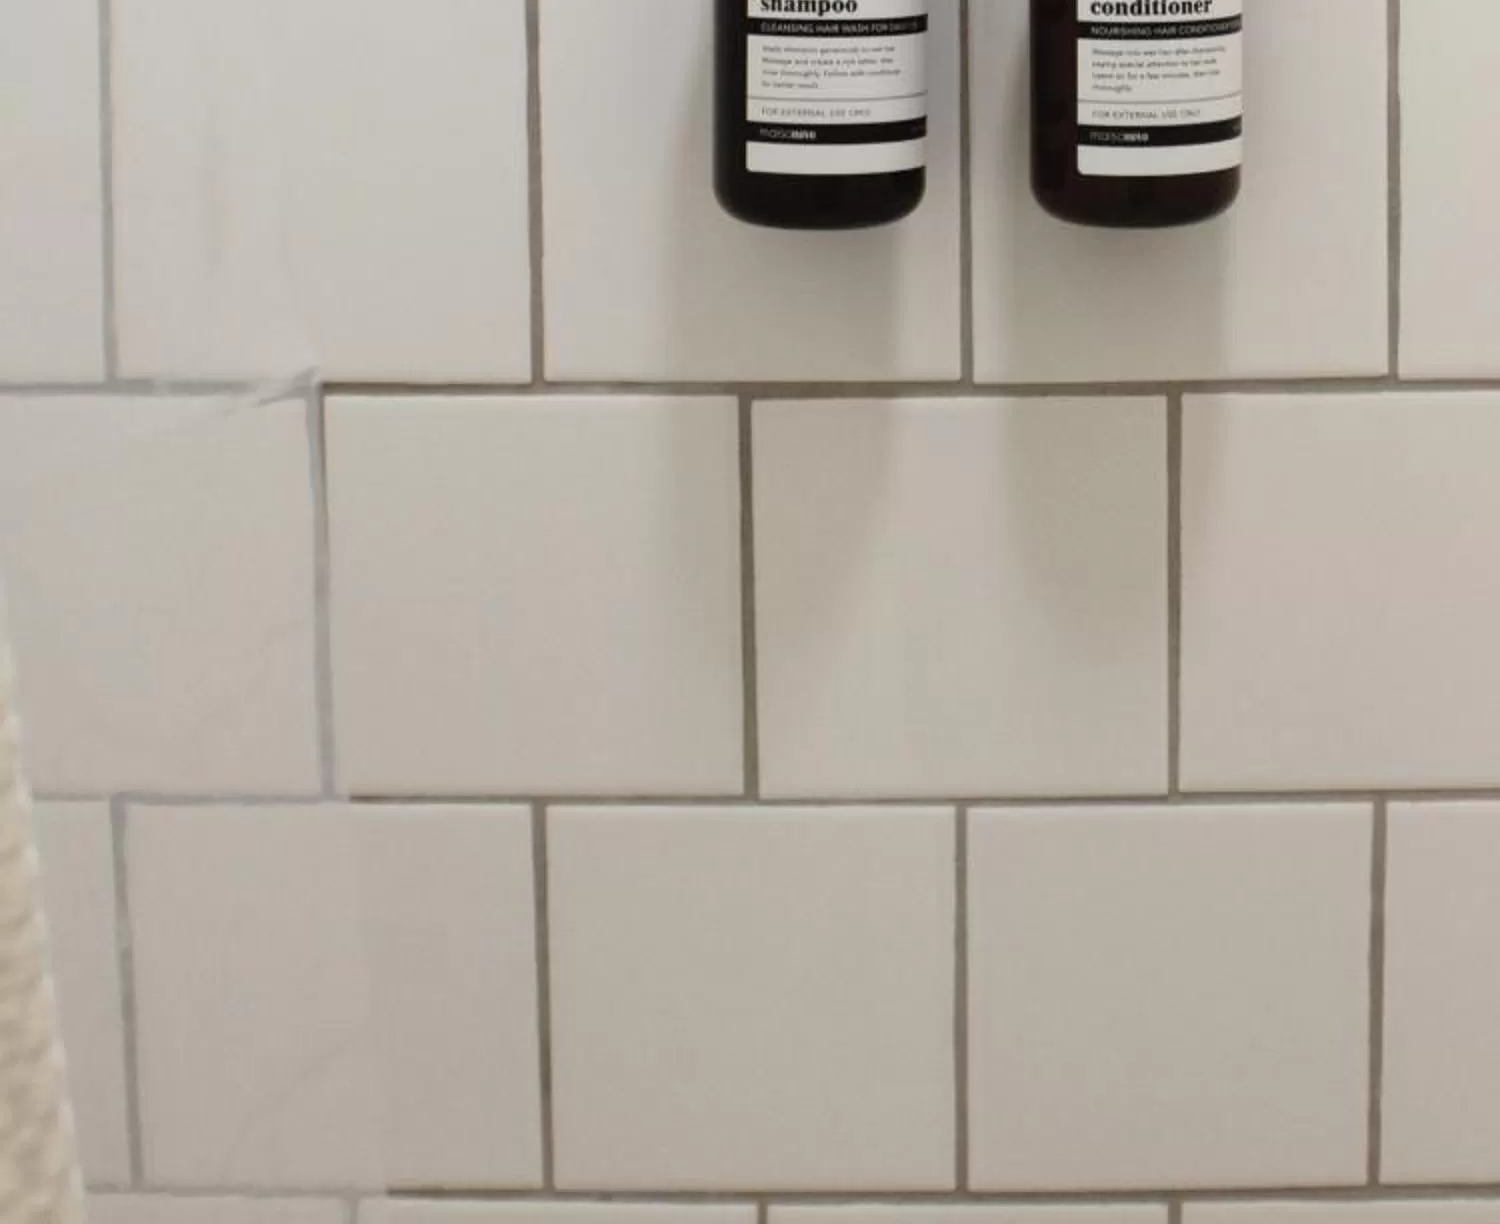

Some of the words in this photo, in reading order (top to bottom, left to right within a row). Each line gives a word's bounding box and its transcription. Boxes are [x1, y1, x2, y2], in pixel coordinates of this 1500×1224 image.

[816, 22, 839, 33] HAIR
[841, 22, 869, 33] WASH
[1091, 25, 1151, 36] NOURISHING
[1153, 25, 1177, 36] HAIR
